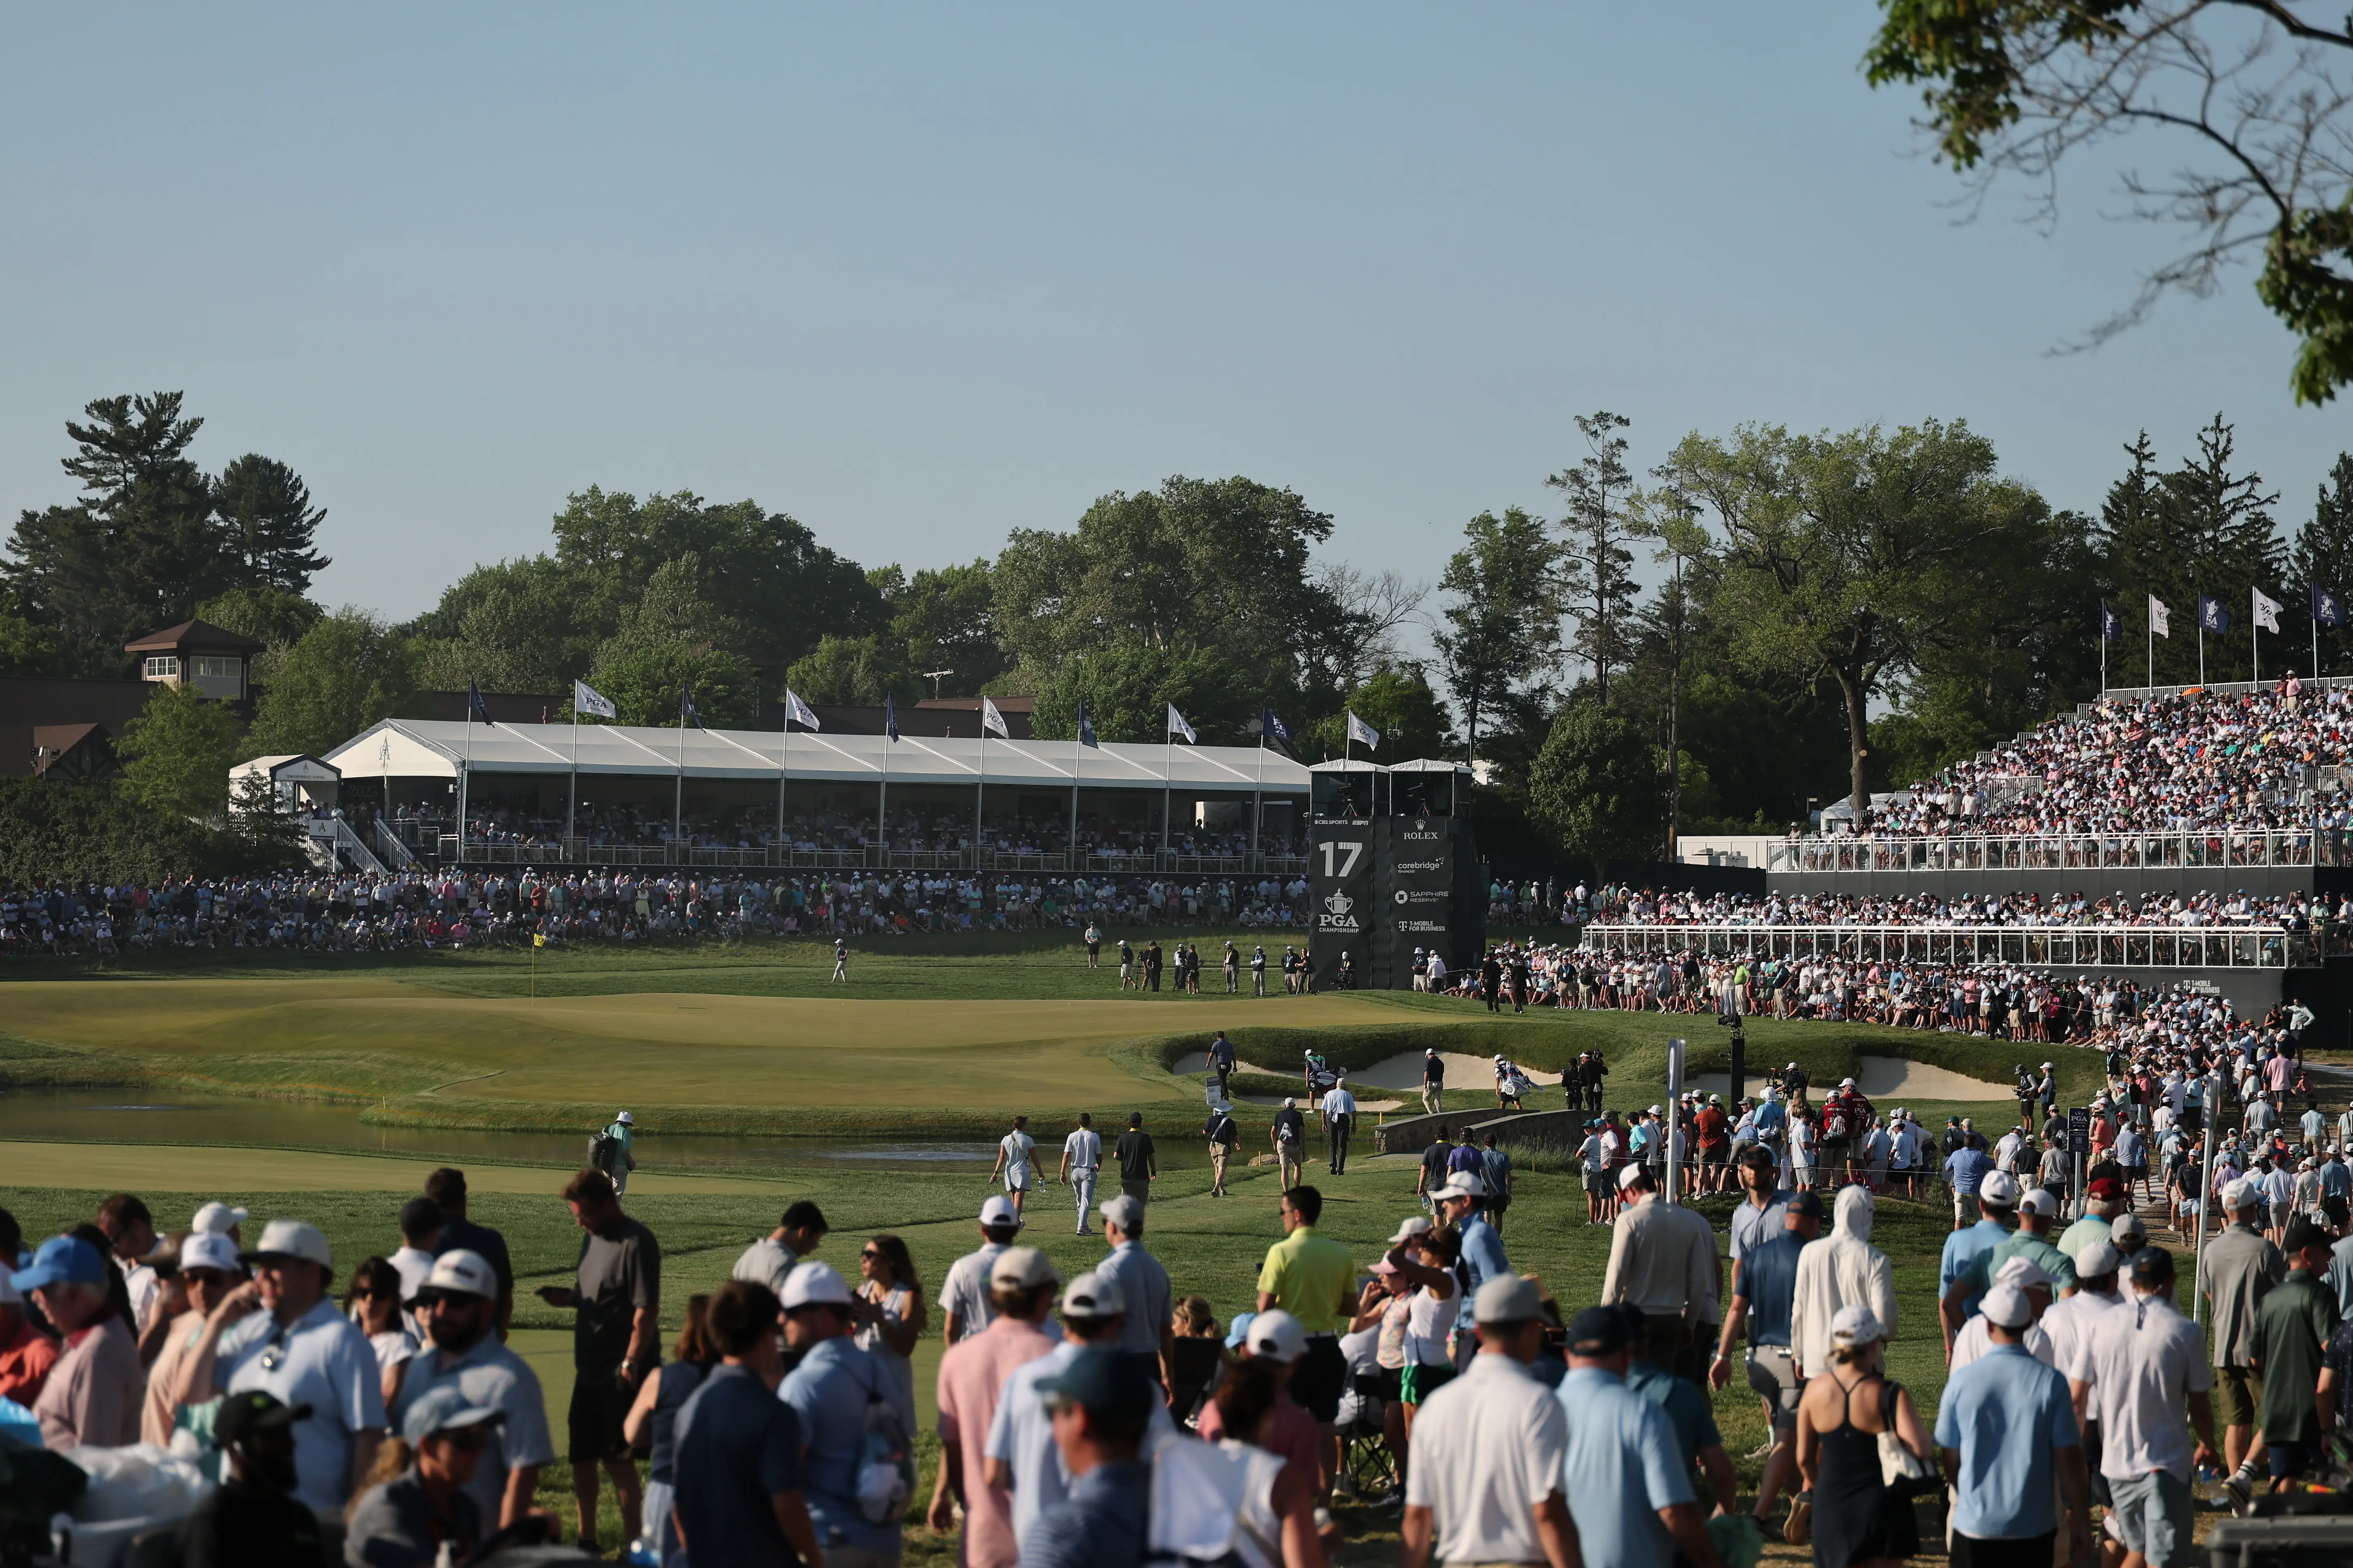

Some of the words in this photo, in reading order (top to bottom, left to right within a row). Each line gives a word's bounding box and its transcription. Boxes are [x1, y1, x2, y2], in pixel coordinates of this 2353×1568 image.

[585, 697, 608, 708] PGA
[795, 706, 813, 719] PGA
[986, 712, 1004, 728] PGA
[1355, 726, 1371, 739] PGA
[349, 784, 378, 798] 2025
[1319, 842, 1362, 877] 17
[1398, 862, 1440, 870] corebridge
[1319, 914, 1359, 927] PGA
